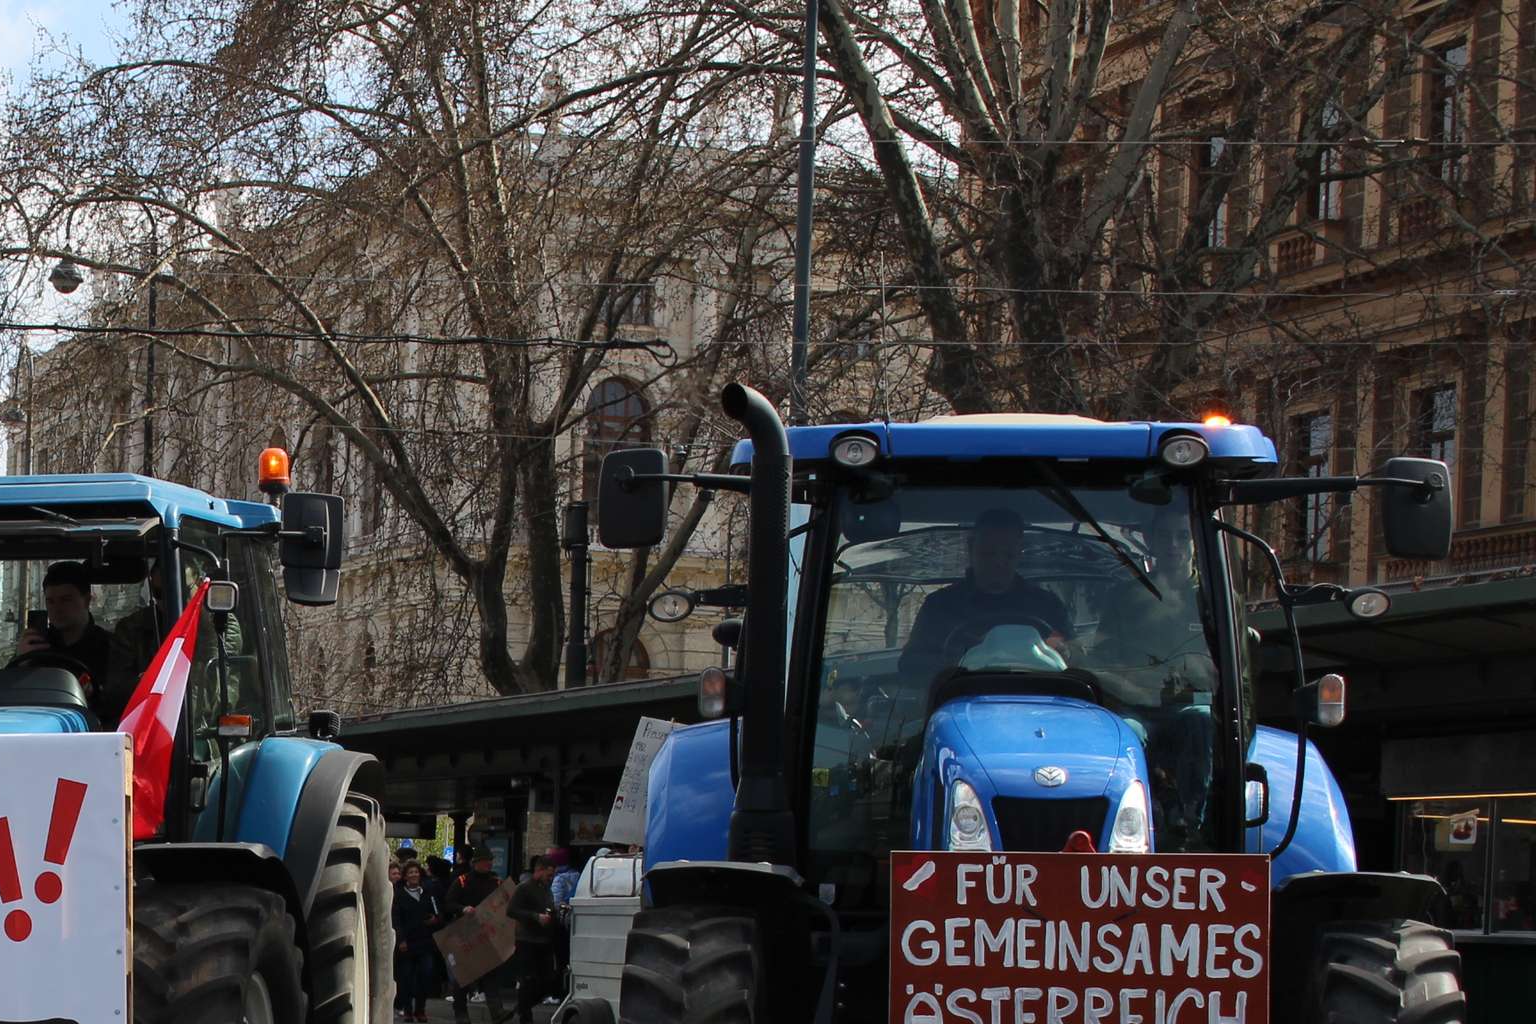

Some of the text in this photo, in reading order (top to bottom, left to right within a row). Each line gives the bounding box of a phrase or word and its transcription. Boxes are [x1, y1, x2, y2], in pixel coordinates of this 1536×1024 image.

[956, 855, 1227, 912] FÜR UNSER
[900, 917, 1263, 978] GEMEINSAMES
